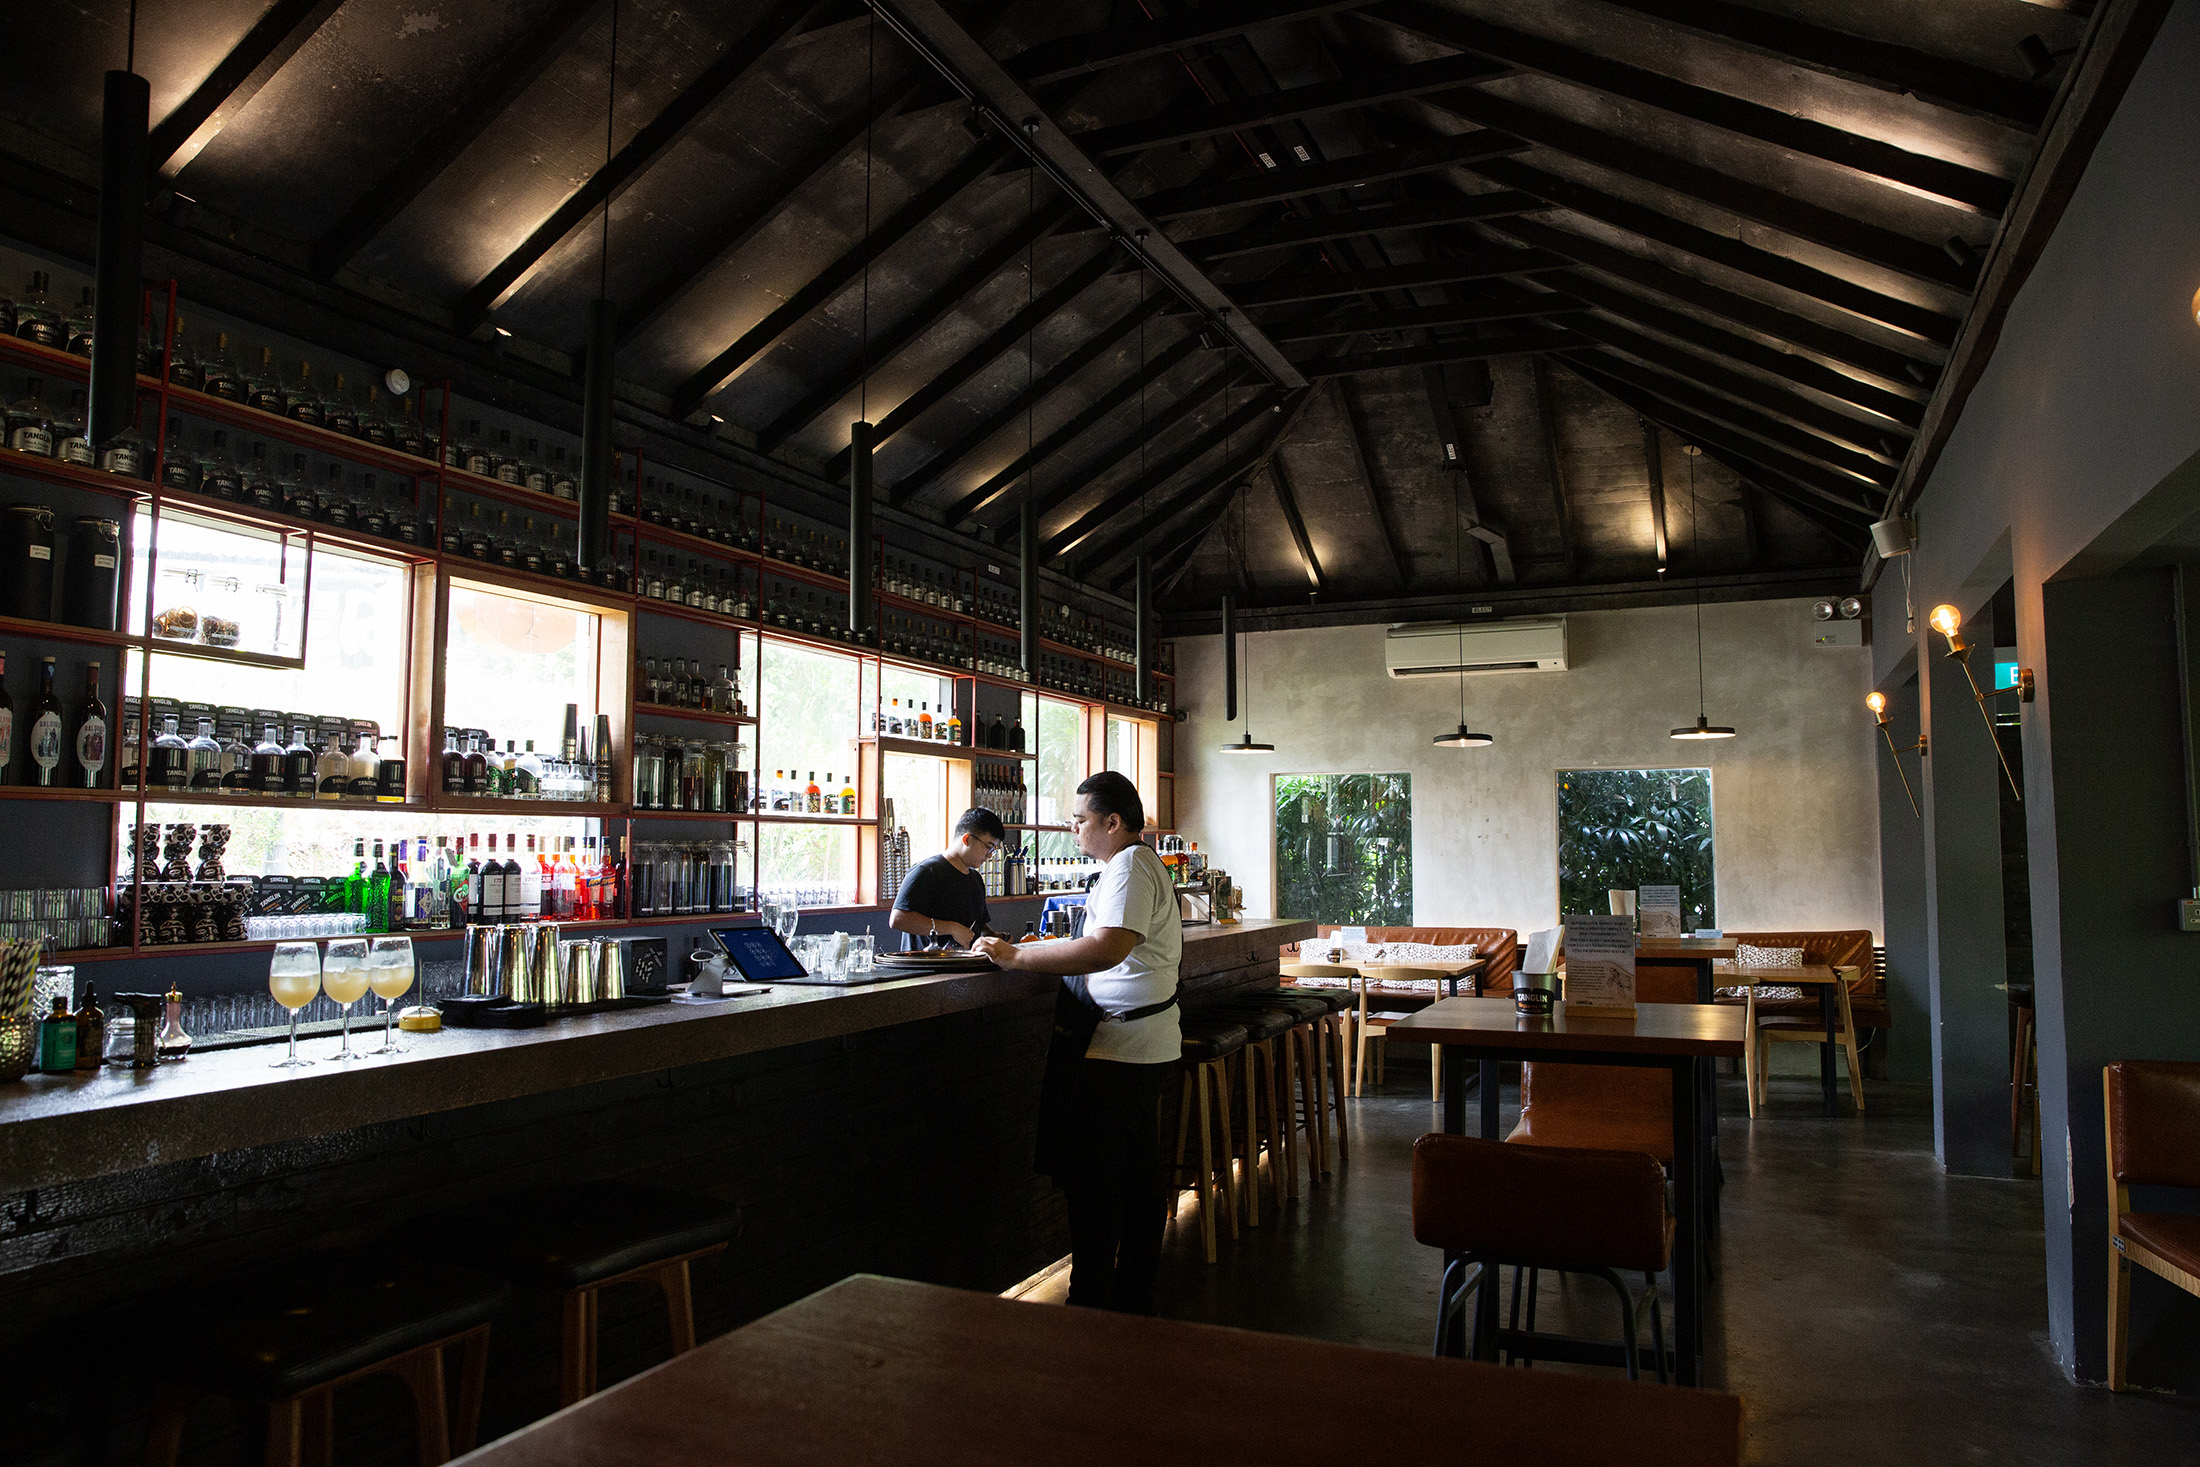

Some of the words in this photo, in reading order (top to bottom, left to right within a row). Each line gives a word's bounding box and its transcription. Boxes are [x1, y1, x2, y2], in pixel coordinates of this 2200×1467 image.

[259, 892, 282, 908] TANGLIN
[290, 893, 311, 910] TANGLIN
[1517, 993, 1548, 1003] TANGLIN
